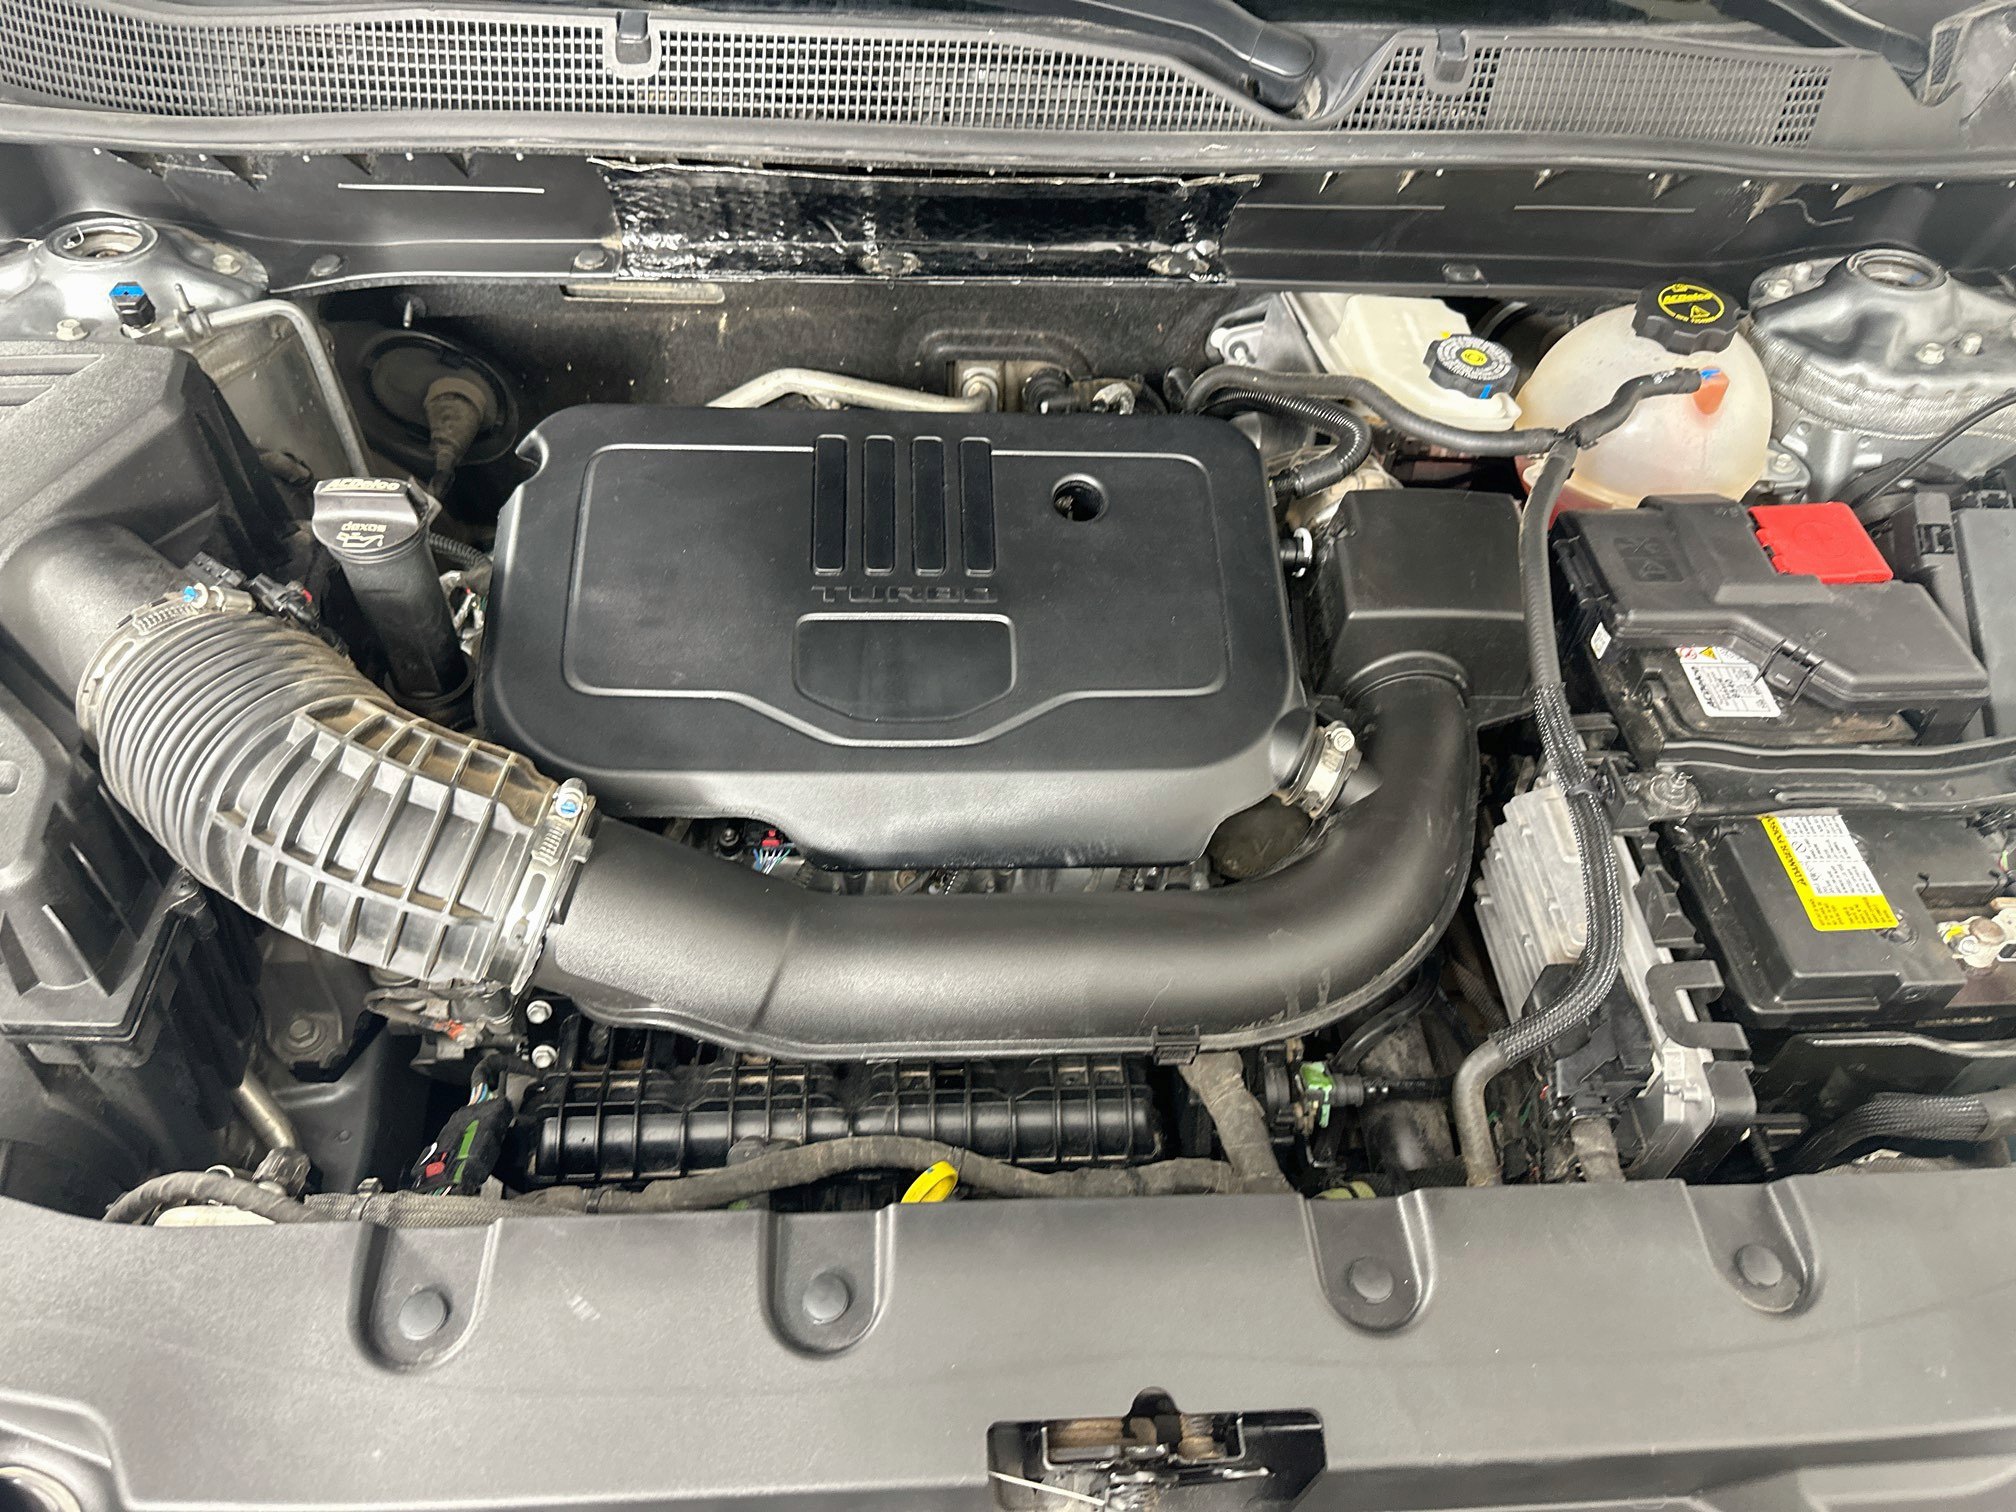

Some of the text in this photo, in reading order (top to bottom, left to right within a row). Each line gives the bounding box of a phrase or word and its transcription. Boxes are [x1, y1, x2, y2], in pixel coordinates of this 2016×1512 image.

[320, 478, 400, 492] ACDelco
[341, 521, 387, 533] dexos
[811, 585, 998, 604] TURBO
